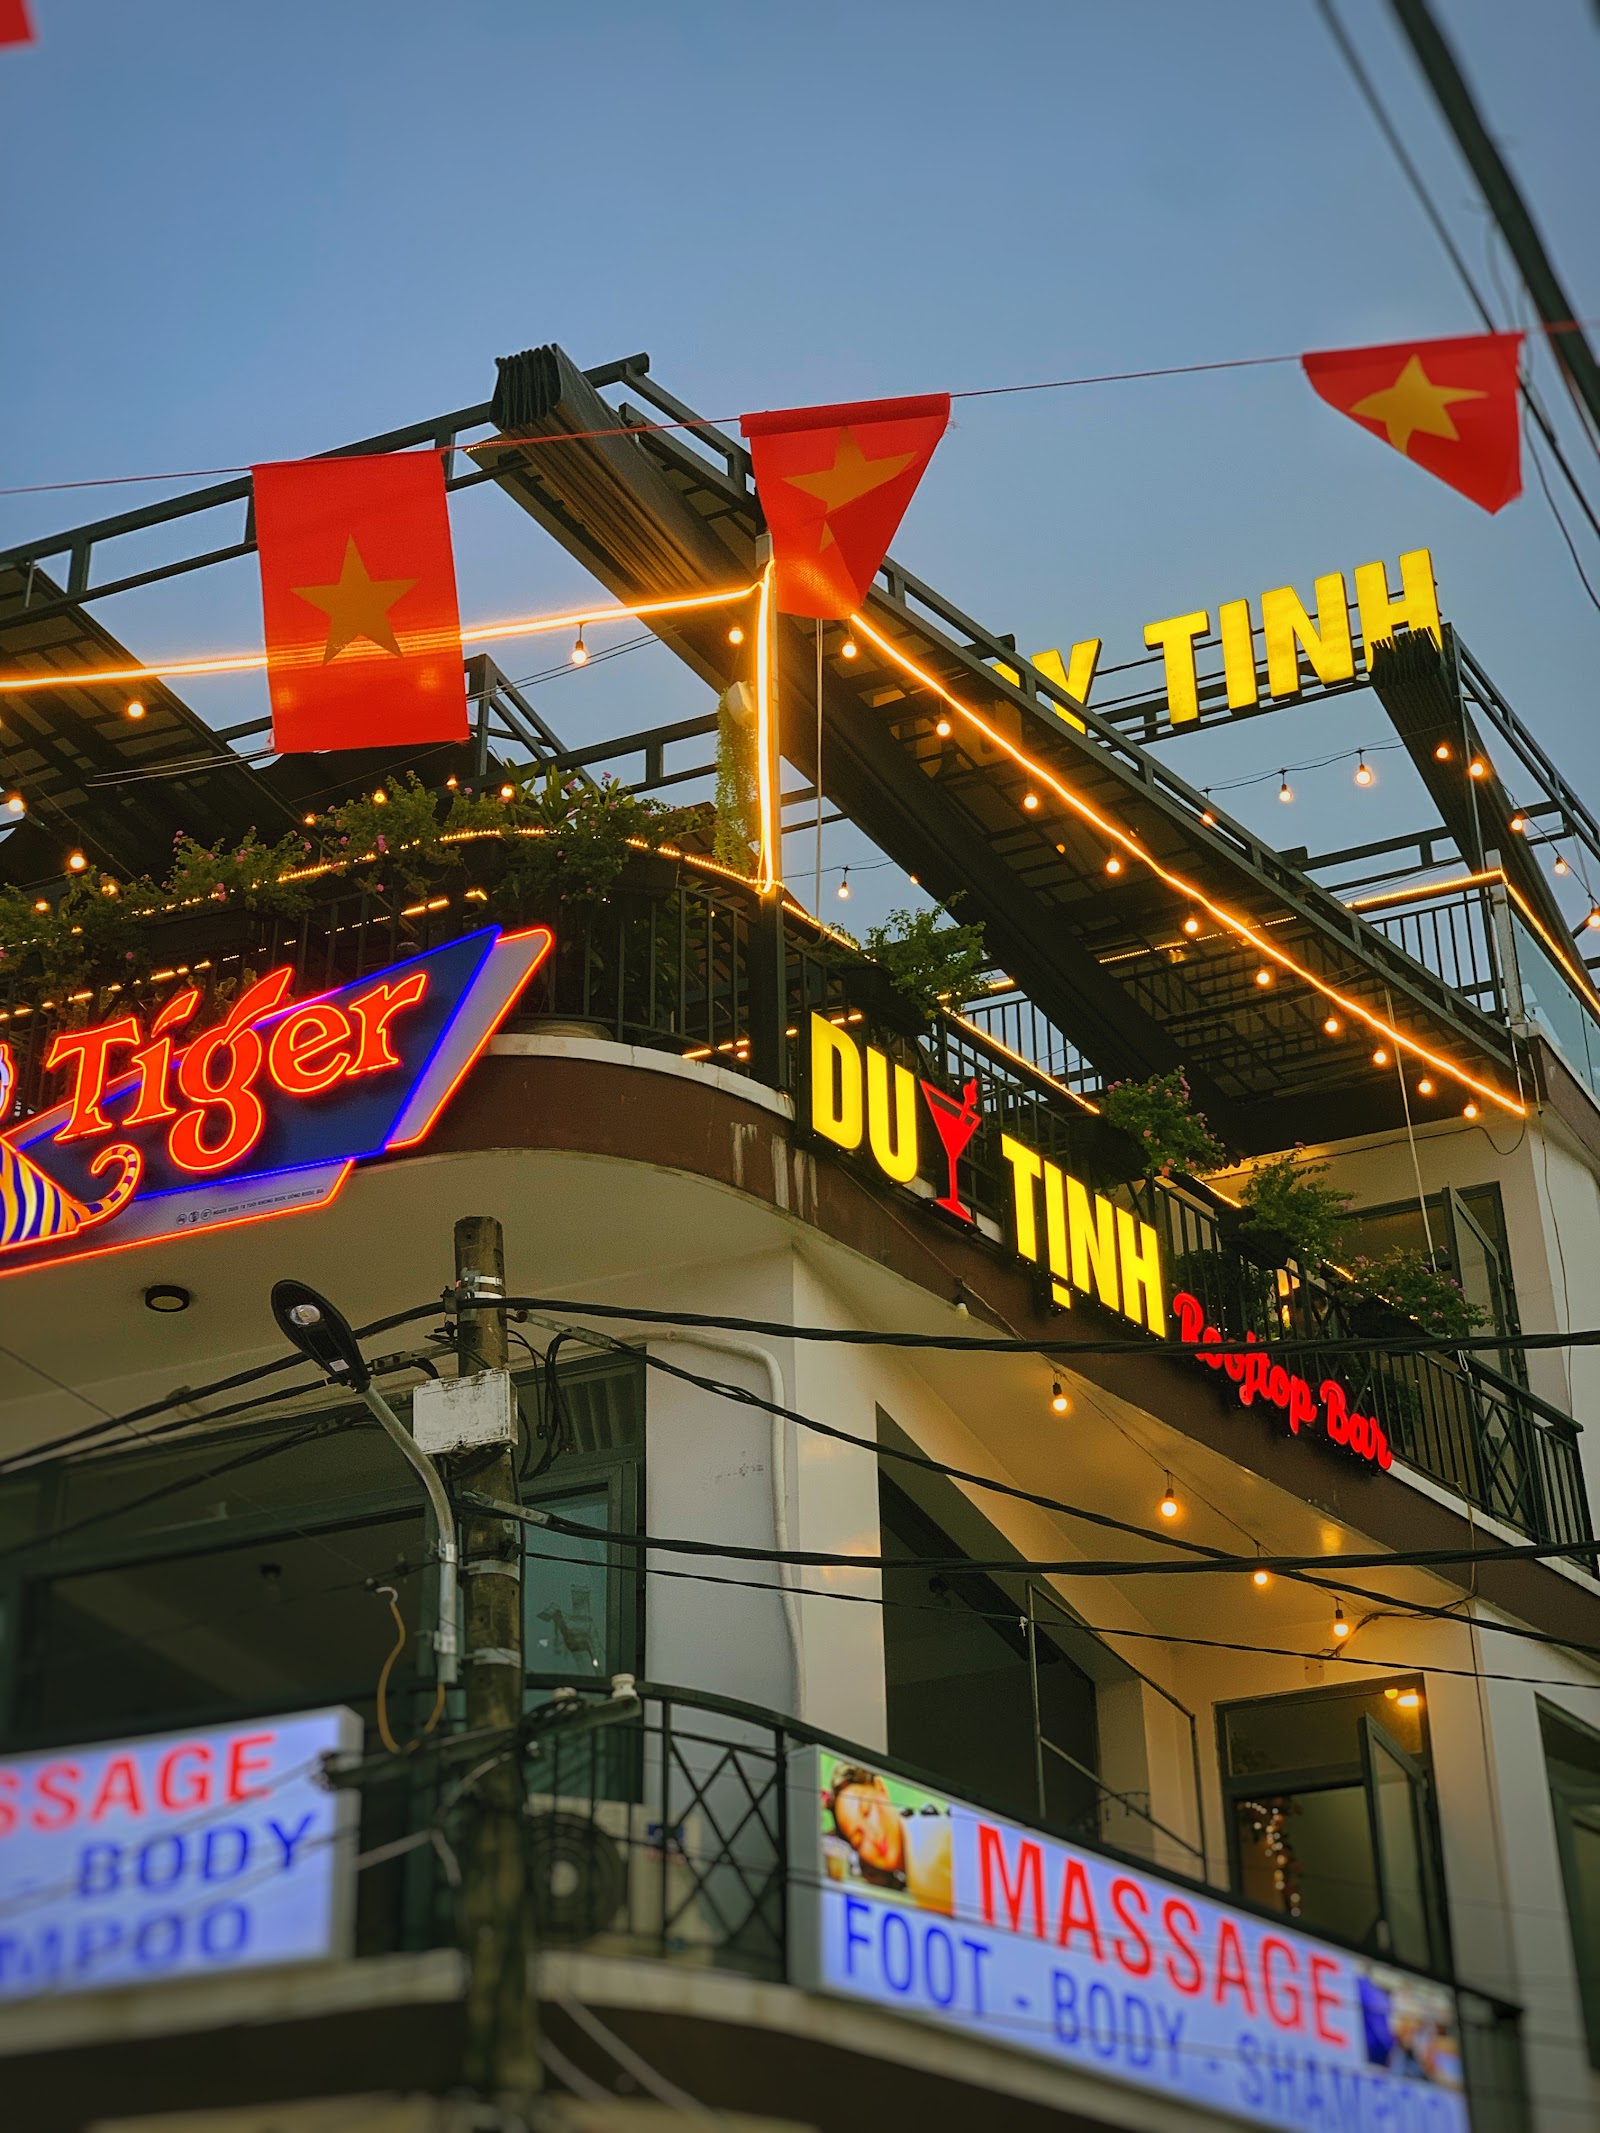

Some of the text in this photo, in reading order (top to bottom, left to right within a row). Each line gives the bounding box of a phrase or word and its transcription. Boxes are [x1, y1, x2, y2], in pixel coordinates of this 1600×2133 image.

[1143, 547, 1443, 725] TINH
[46, 966, 429, 1172] Tiger
[1173, 1291, 1393, 1470] Rooftop Bar
[77, 1812, 318, 1898] BODY
[976, 1821, 1349, 2048] MASSAGE
[843, 1893, 993, 2017] FOOT
[1050, 1966, 1186, 2081] BODY
